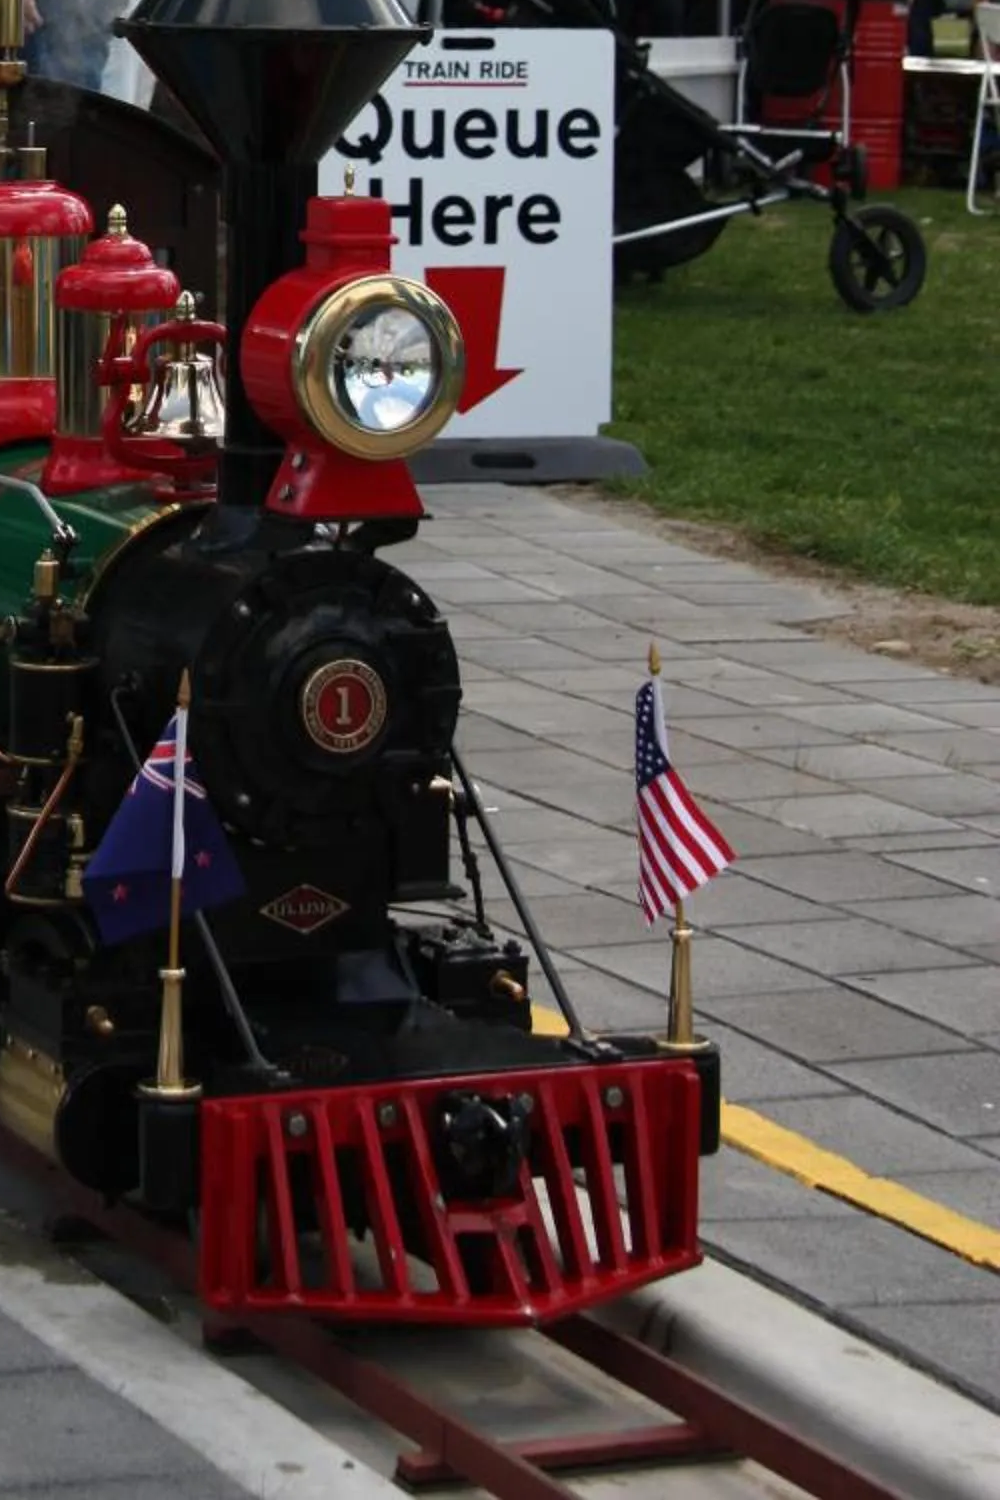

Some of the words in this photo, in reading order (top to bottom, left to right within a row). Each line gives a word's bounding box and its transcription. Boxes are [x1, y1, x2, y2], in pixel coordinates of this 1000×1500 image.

[405, 61, 470, 80] TRAIN
[479, 61, 529, 80] RIDE
[334, 93, 601, 164] Queue
[368, 177, 561, 247] Here
[335, 687, 352, 725] 1
